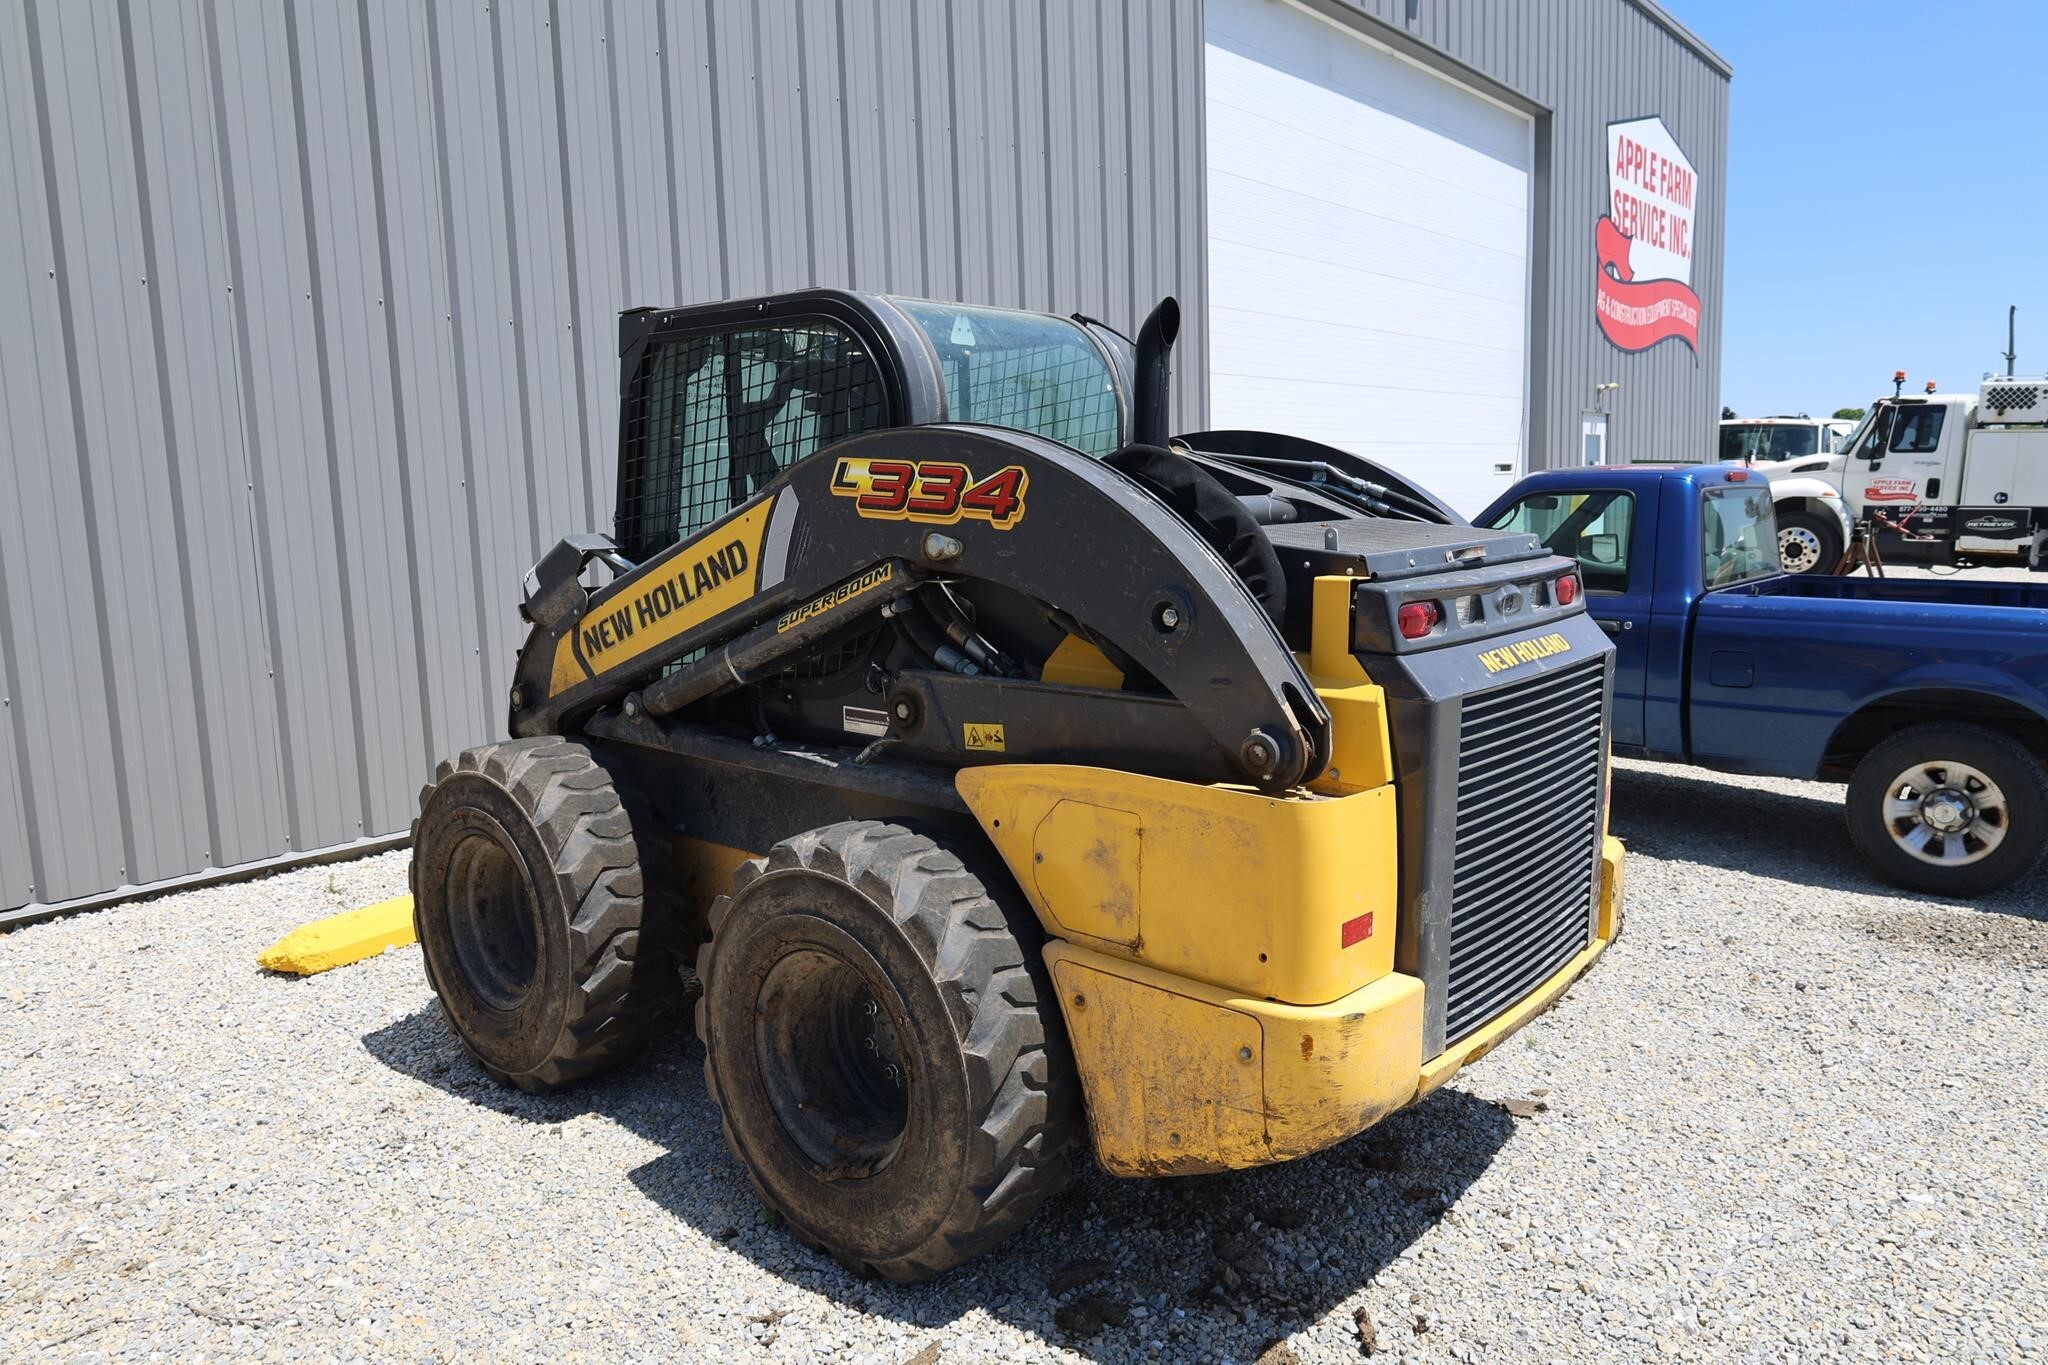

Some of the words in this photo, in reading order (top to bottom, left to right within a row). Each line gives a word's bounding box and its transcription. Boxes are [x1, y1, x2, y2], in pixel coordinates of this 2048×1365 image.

[1616, 134, 1657, 193] APPLE
[1659, 157, 1691, 210] FARM
[1612, 189, 1665, 249] SERVICE
[1668, 214, 1691, 260] INC.
[1610, 297, 1647, 326] CONSTRUCTION
[832, 458, 1027, 525] L334
[582, 605, 634, 658] NEW
[636, 539, 748, 631] HOLLAND
[778, 592, 835, 632] SUPER
[835, 562, 893, 603] BOOM
[1478, 646, 1520, 673] NEW
[1510, 633, 1571, 663] HOLLAND
